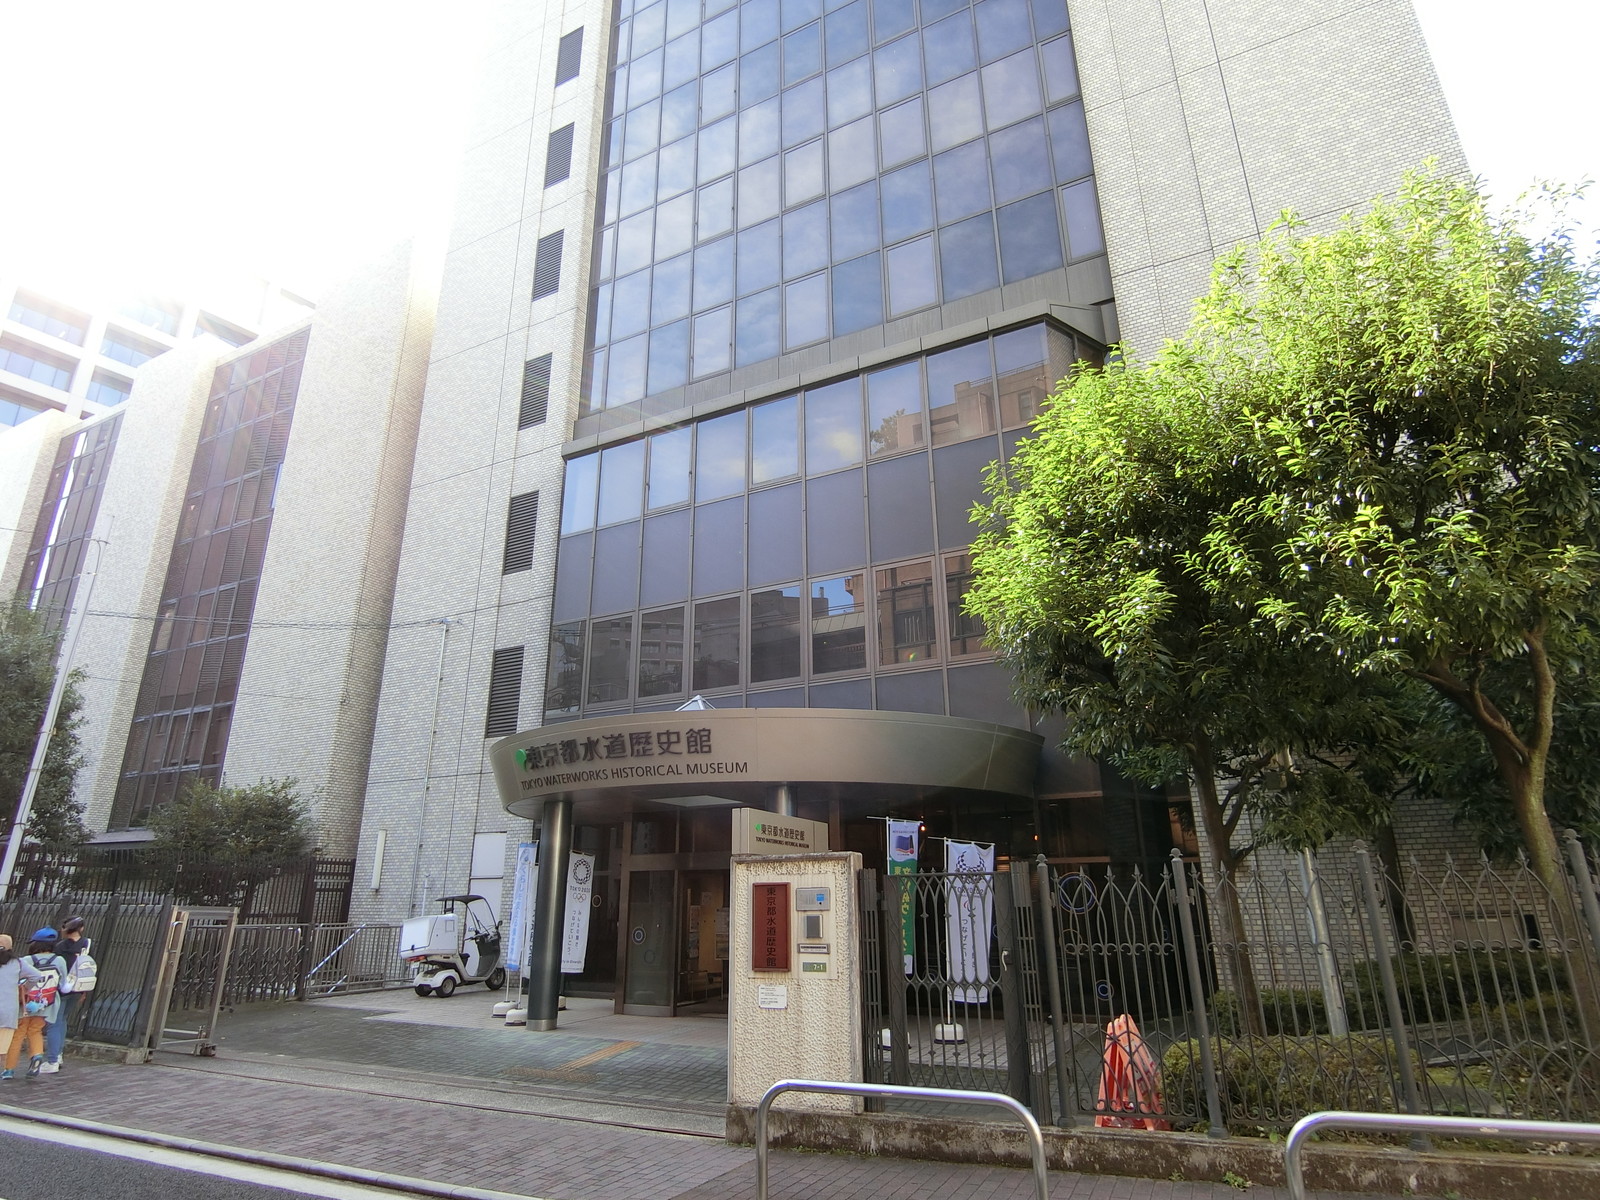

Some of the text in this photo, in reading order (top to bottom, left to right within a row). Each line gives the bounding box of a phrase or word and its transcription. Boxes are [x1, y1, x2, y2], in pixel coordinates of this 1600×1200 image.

[526, 728, 712, 770] 東京都水道歴史館
[521, 761, 748, 792] TOKYO WATERWORKS HISTORICAL MUSEUM
[766, 887, 777, 967] 東京都水道歴史館
